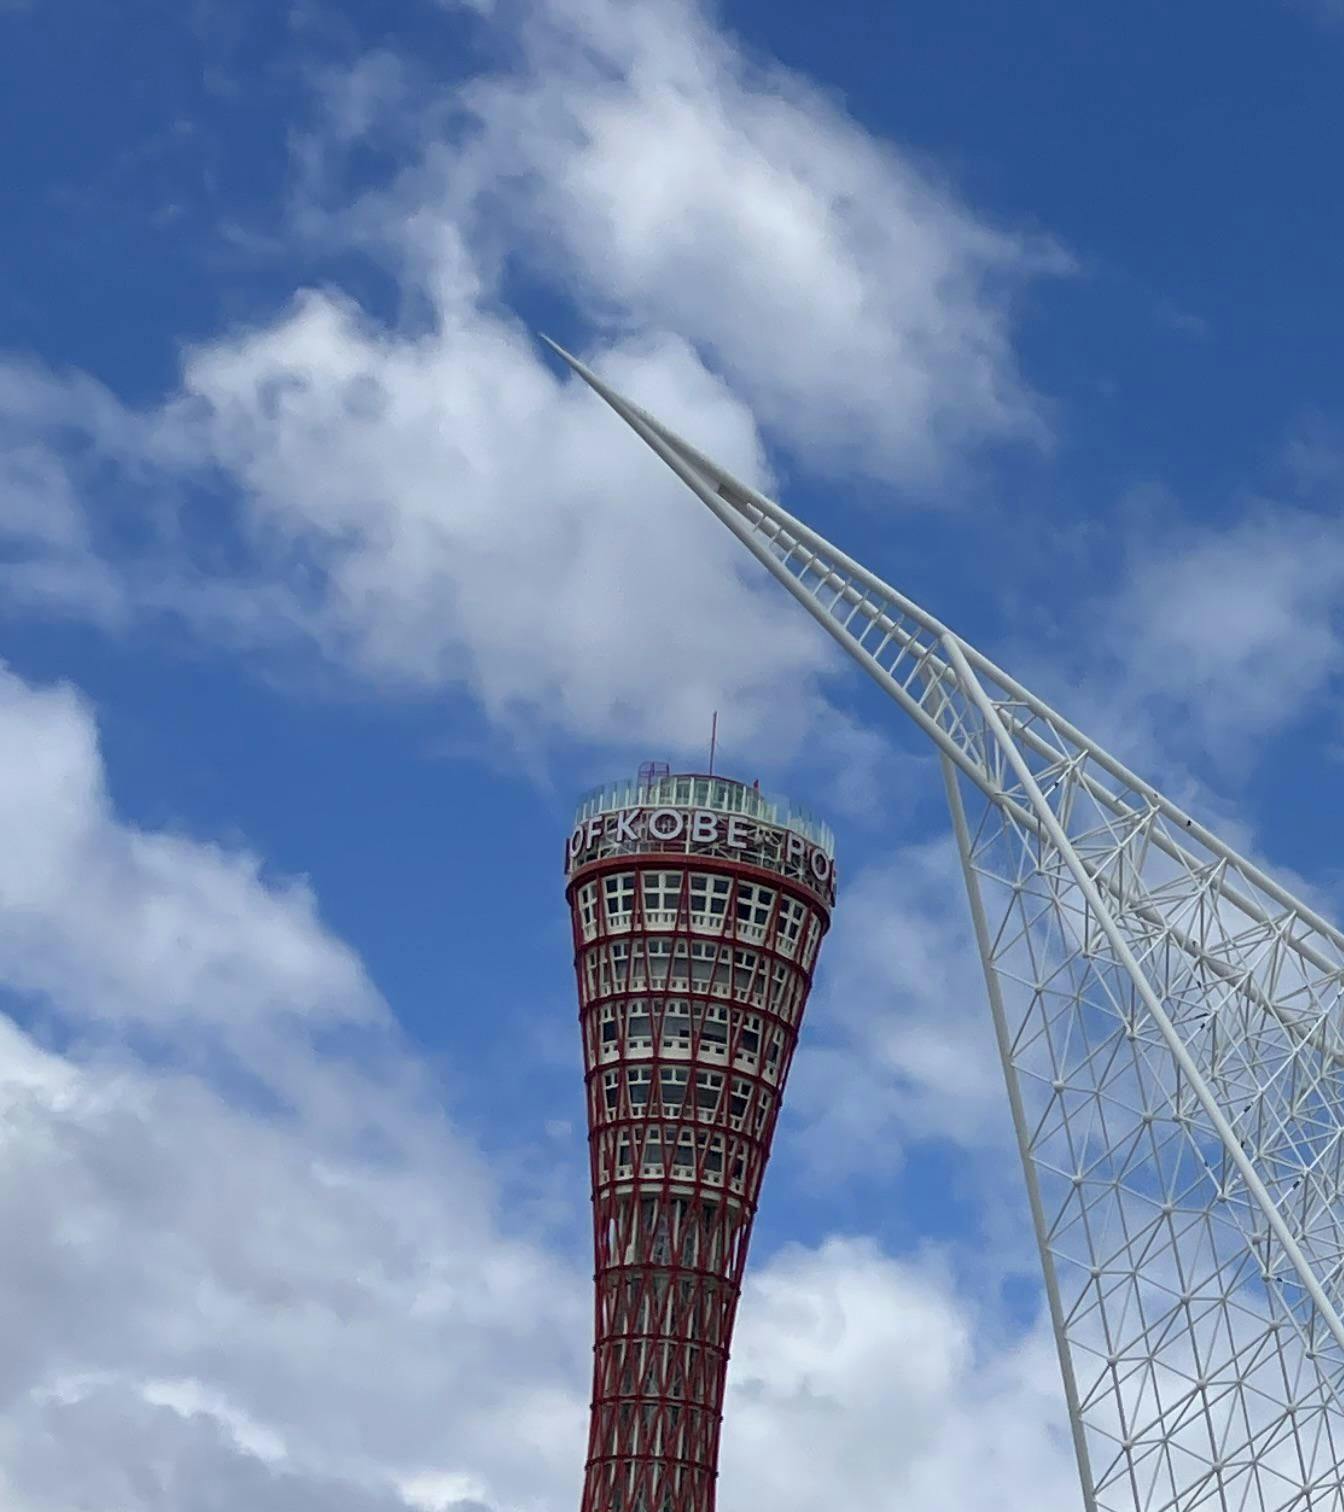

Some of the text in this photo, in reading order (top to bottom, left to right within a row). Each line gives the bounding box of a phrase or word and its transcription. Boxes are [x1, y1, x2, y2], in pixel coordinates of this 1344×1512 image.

[570, 809, 831, 881] OF KOBE PO
